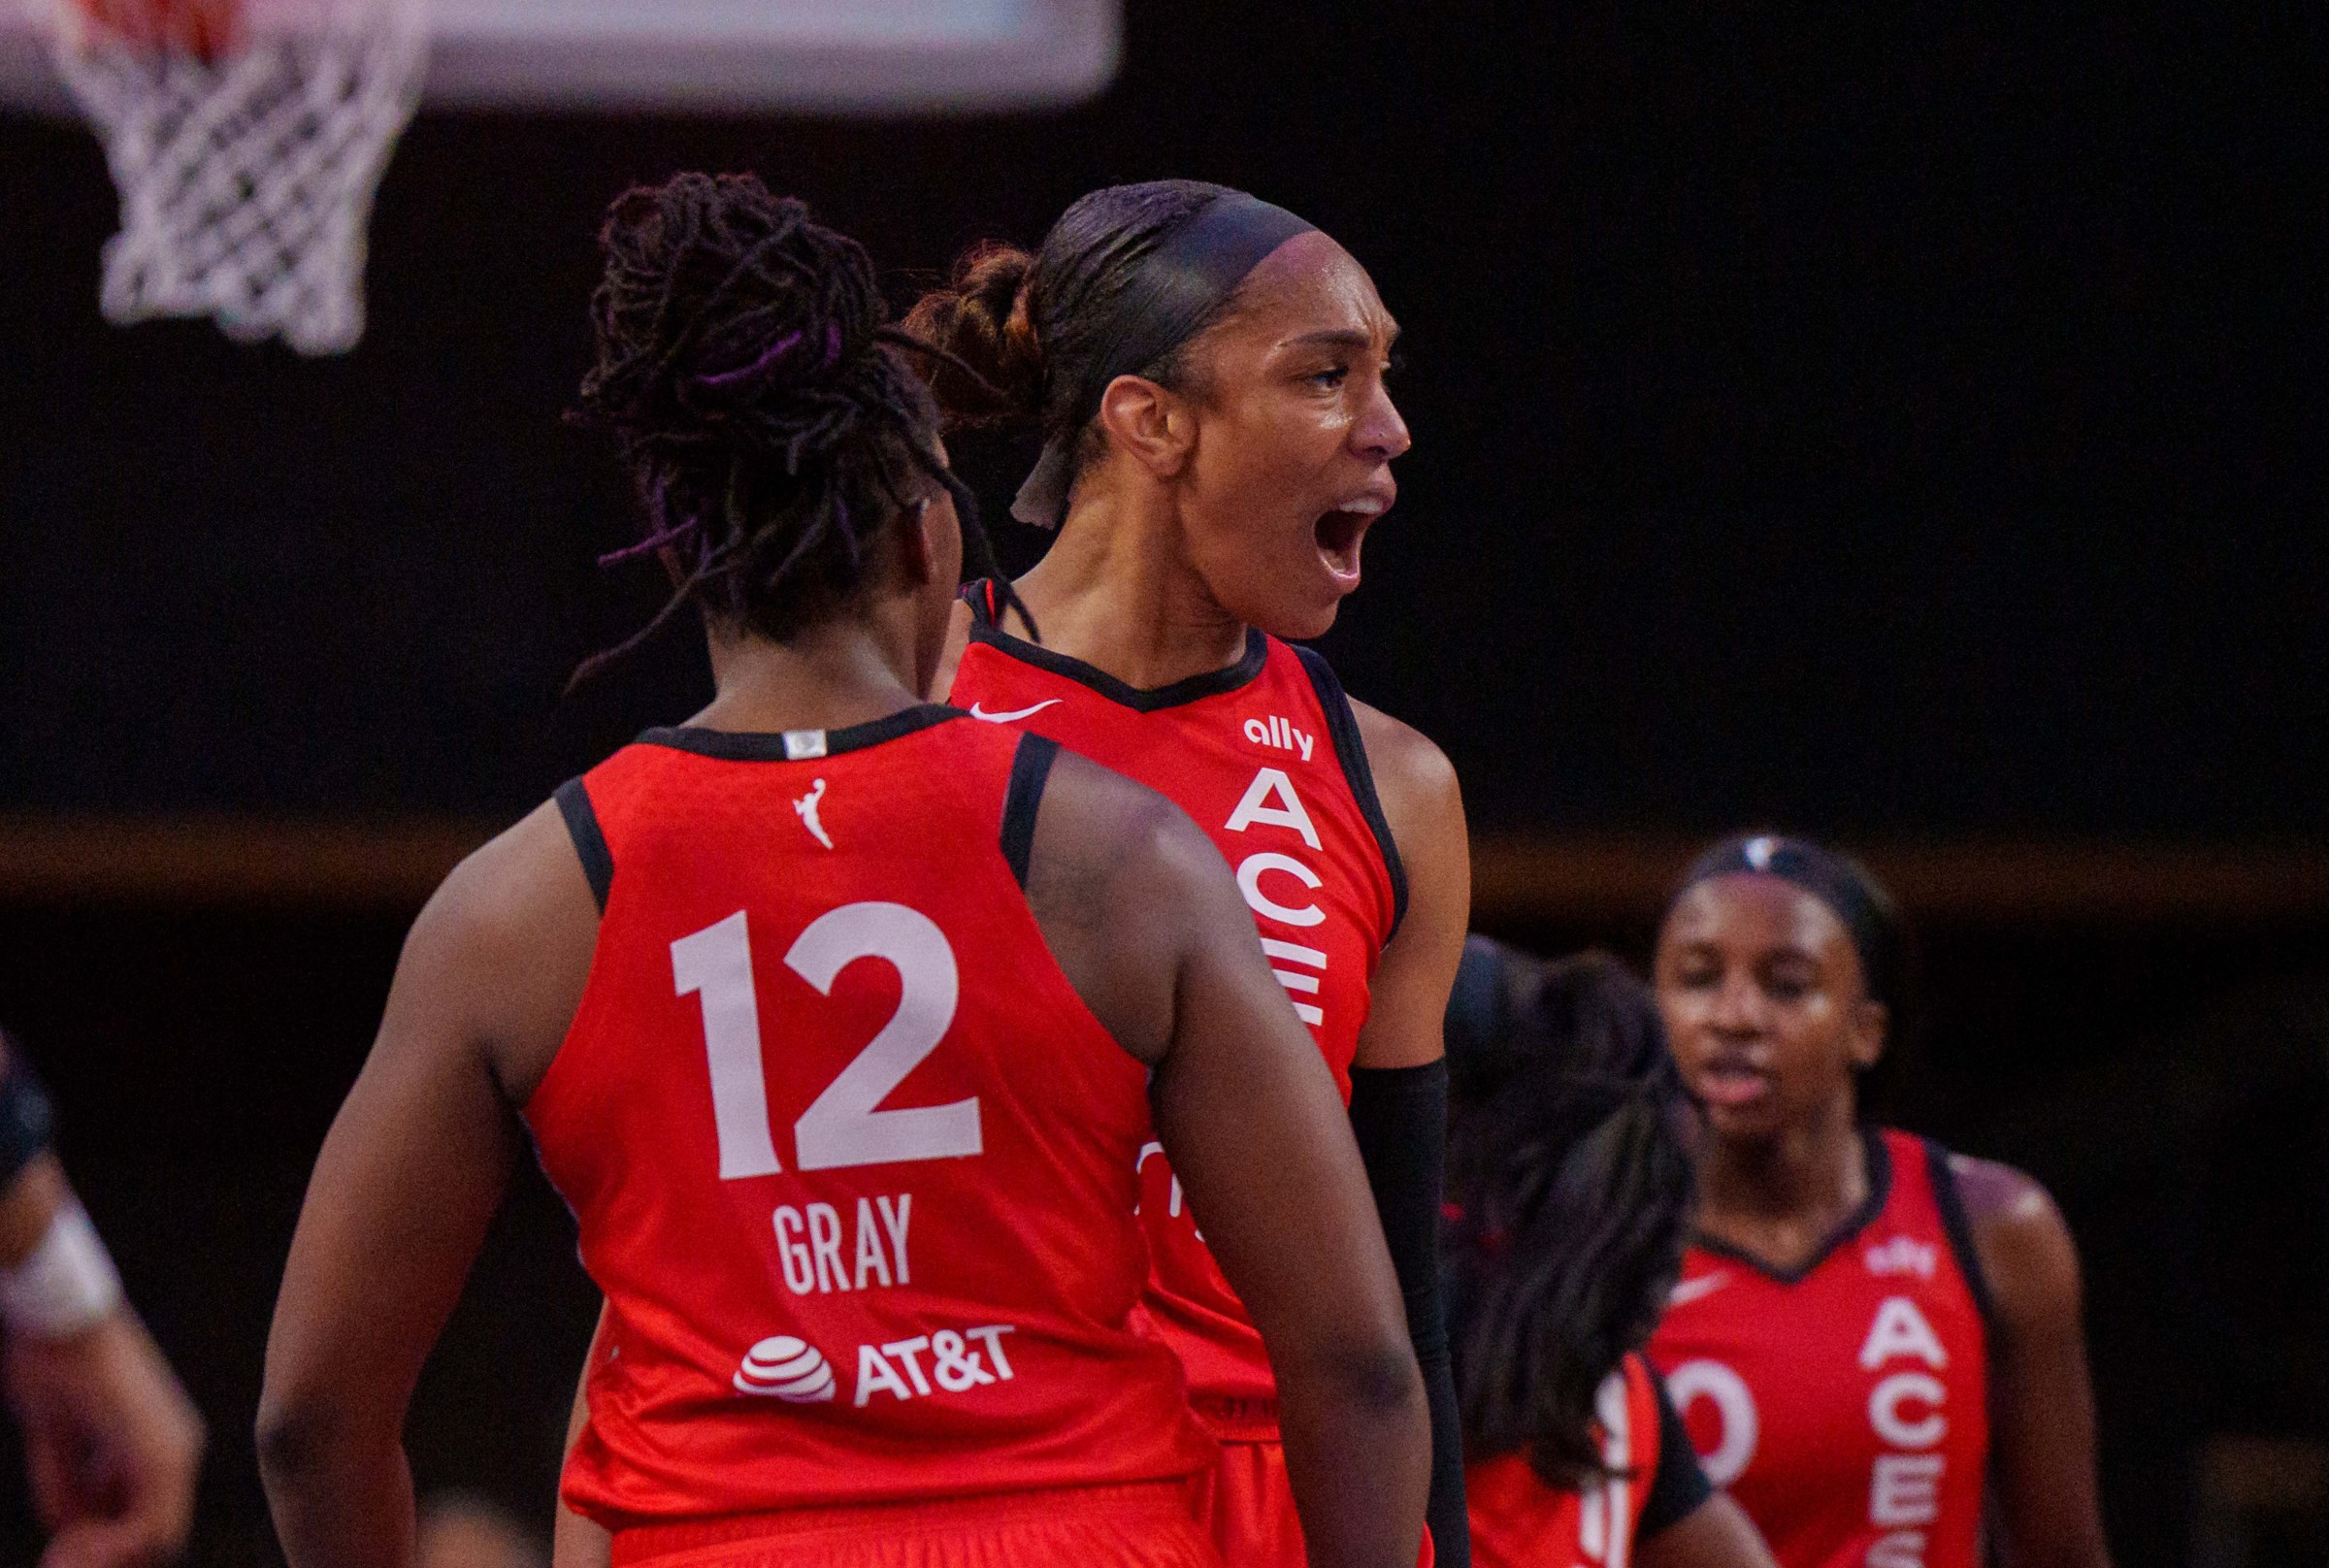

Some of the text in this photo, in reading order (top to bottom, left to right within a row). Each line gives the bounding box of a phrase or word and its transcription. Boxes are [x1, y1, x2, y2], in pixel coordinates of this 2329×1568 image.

[1243, 714, 1314, 762] ally
[670, 900, 982, 1180] 12
[772, 1192, 911, 1295] GRAY
[854, 1323, 1015, 1408] AT&T
